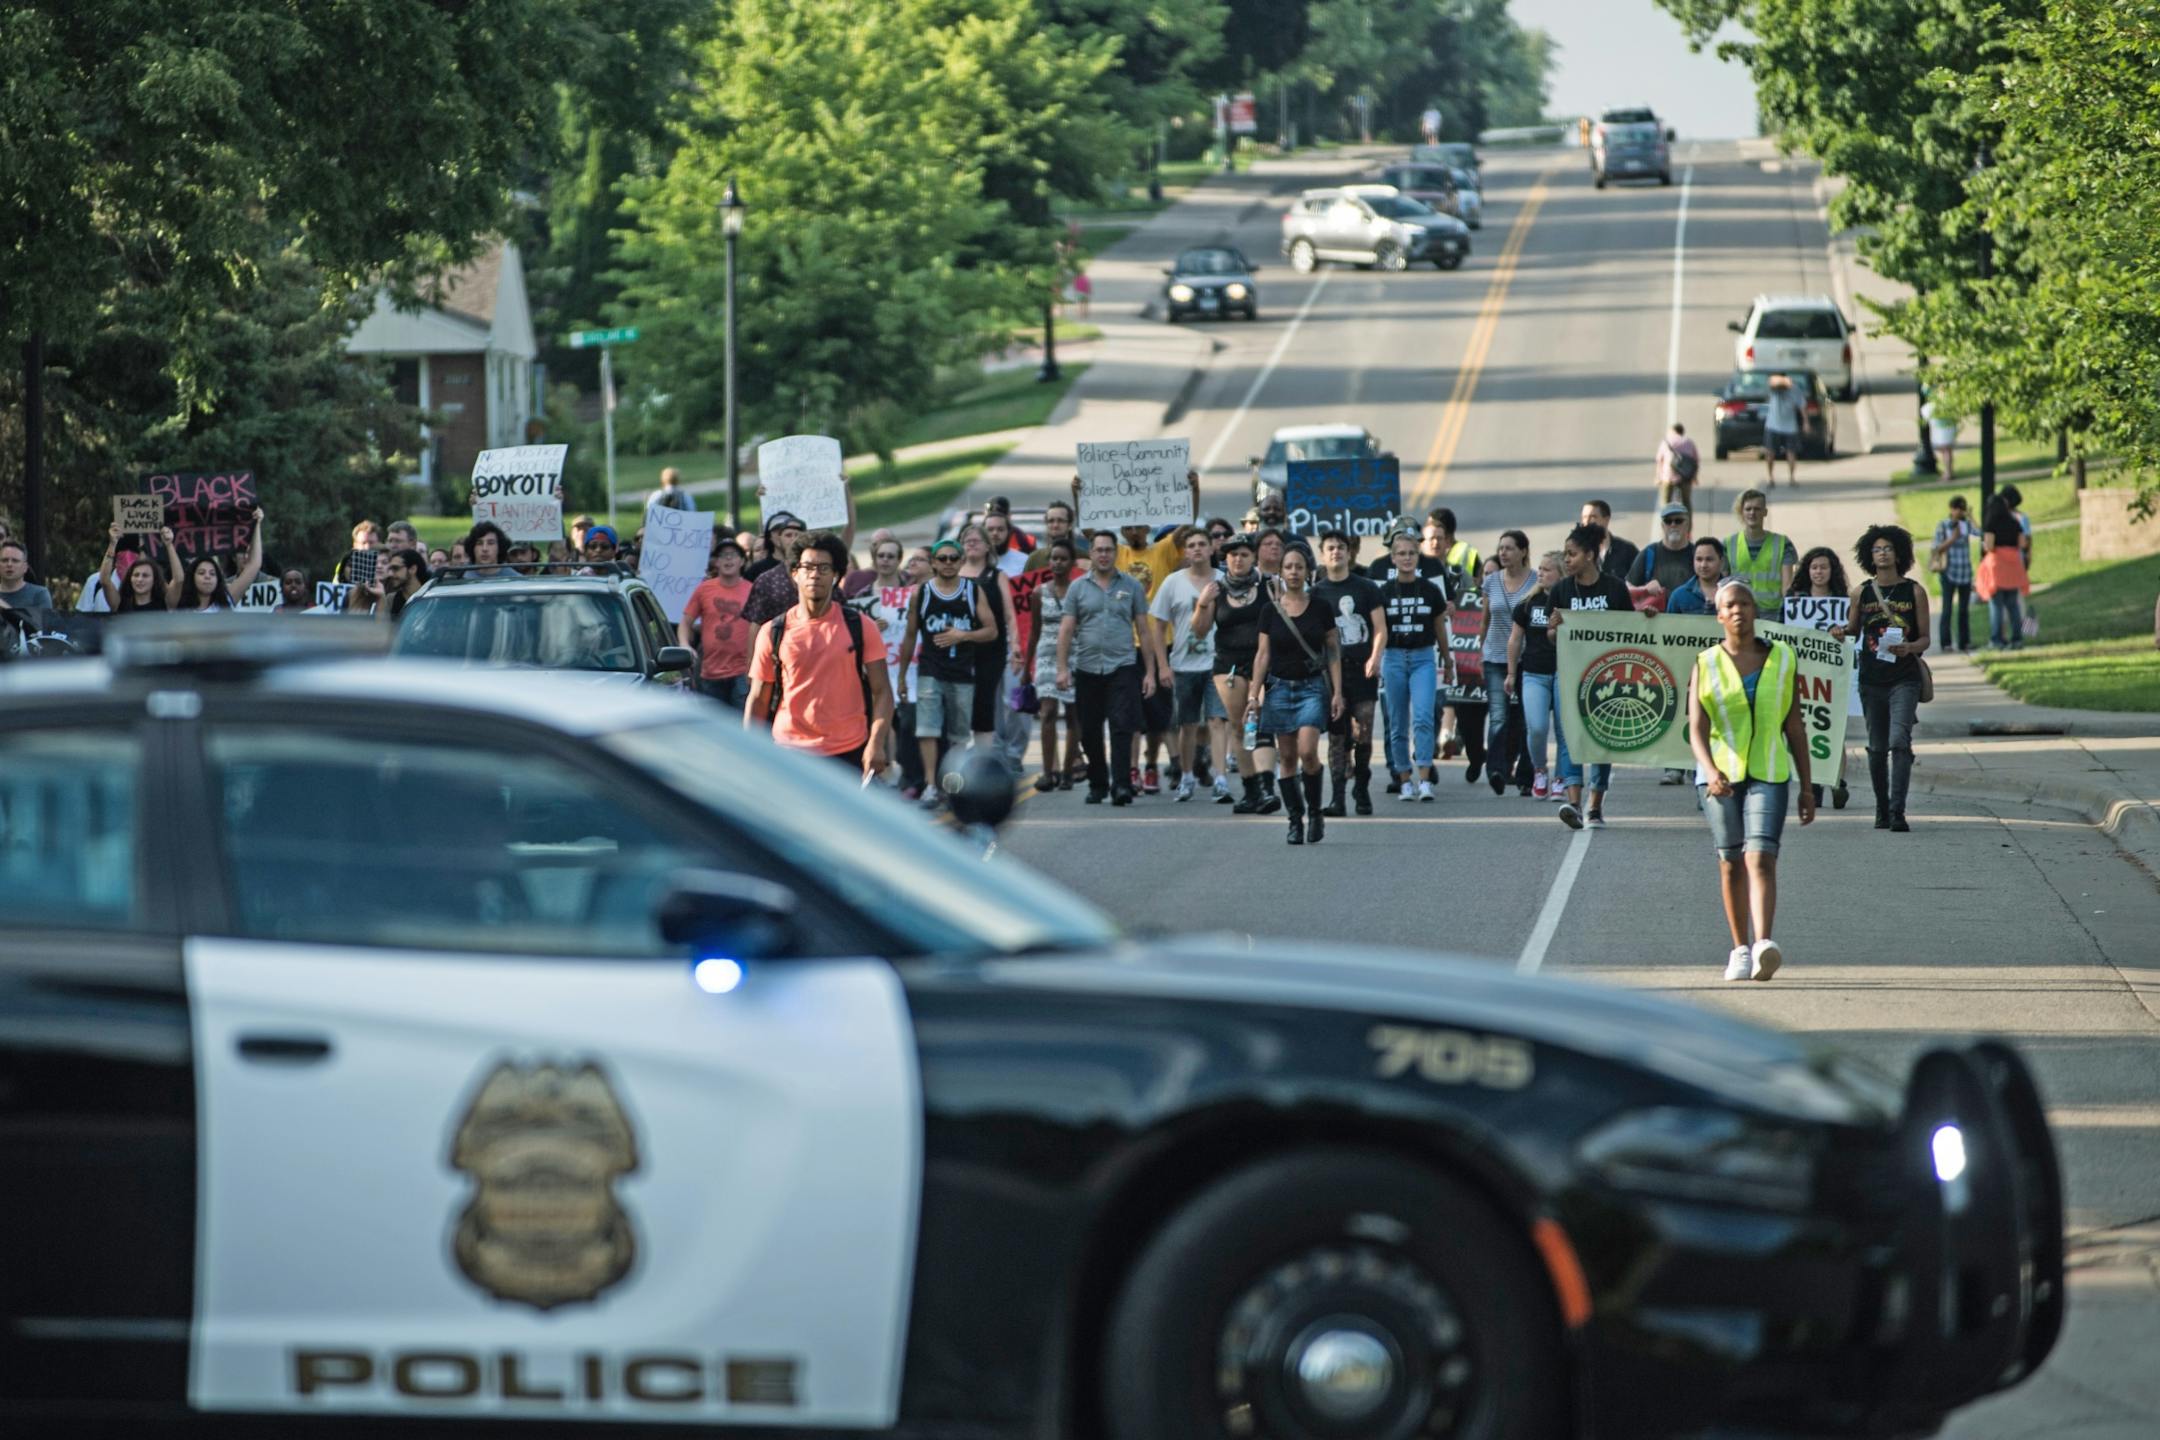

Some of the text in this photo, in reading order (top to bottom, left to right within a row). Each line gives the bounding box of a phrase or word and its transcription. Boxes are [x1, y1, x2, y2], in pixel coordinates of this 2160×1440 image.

[150, 471, 257, 508] BLACK
[475, 472, 559, 498] BOYCOTT
[120, 498, 159, 512] BLACK
[172, 497, 252, 527] IVES
[127, 510, 160, 521] LIVES
[649, 508, 682, 526] NO
[642, 549, 672, 571] NO
[1387, 567, 1423, 580] BLK
[1570, 595, 1609, 611] BLACK
[1569, 629, 1657, 646] INDUSTRIAL
[1763, 630, 1798, 647] TWIN
[1802, 637, 1842, 655] CITIES
[1606, 652, 1645, 663] WORKERS
[1797, 648, 1844, 667] WORLD
[295, 1348, 798, 1406] POLICE
